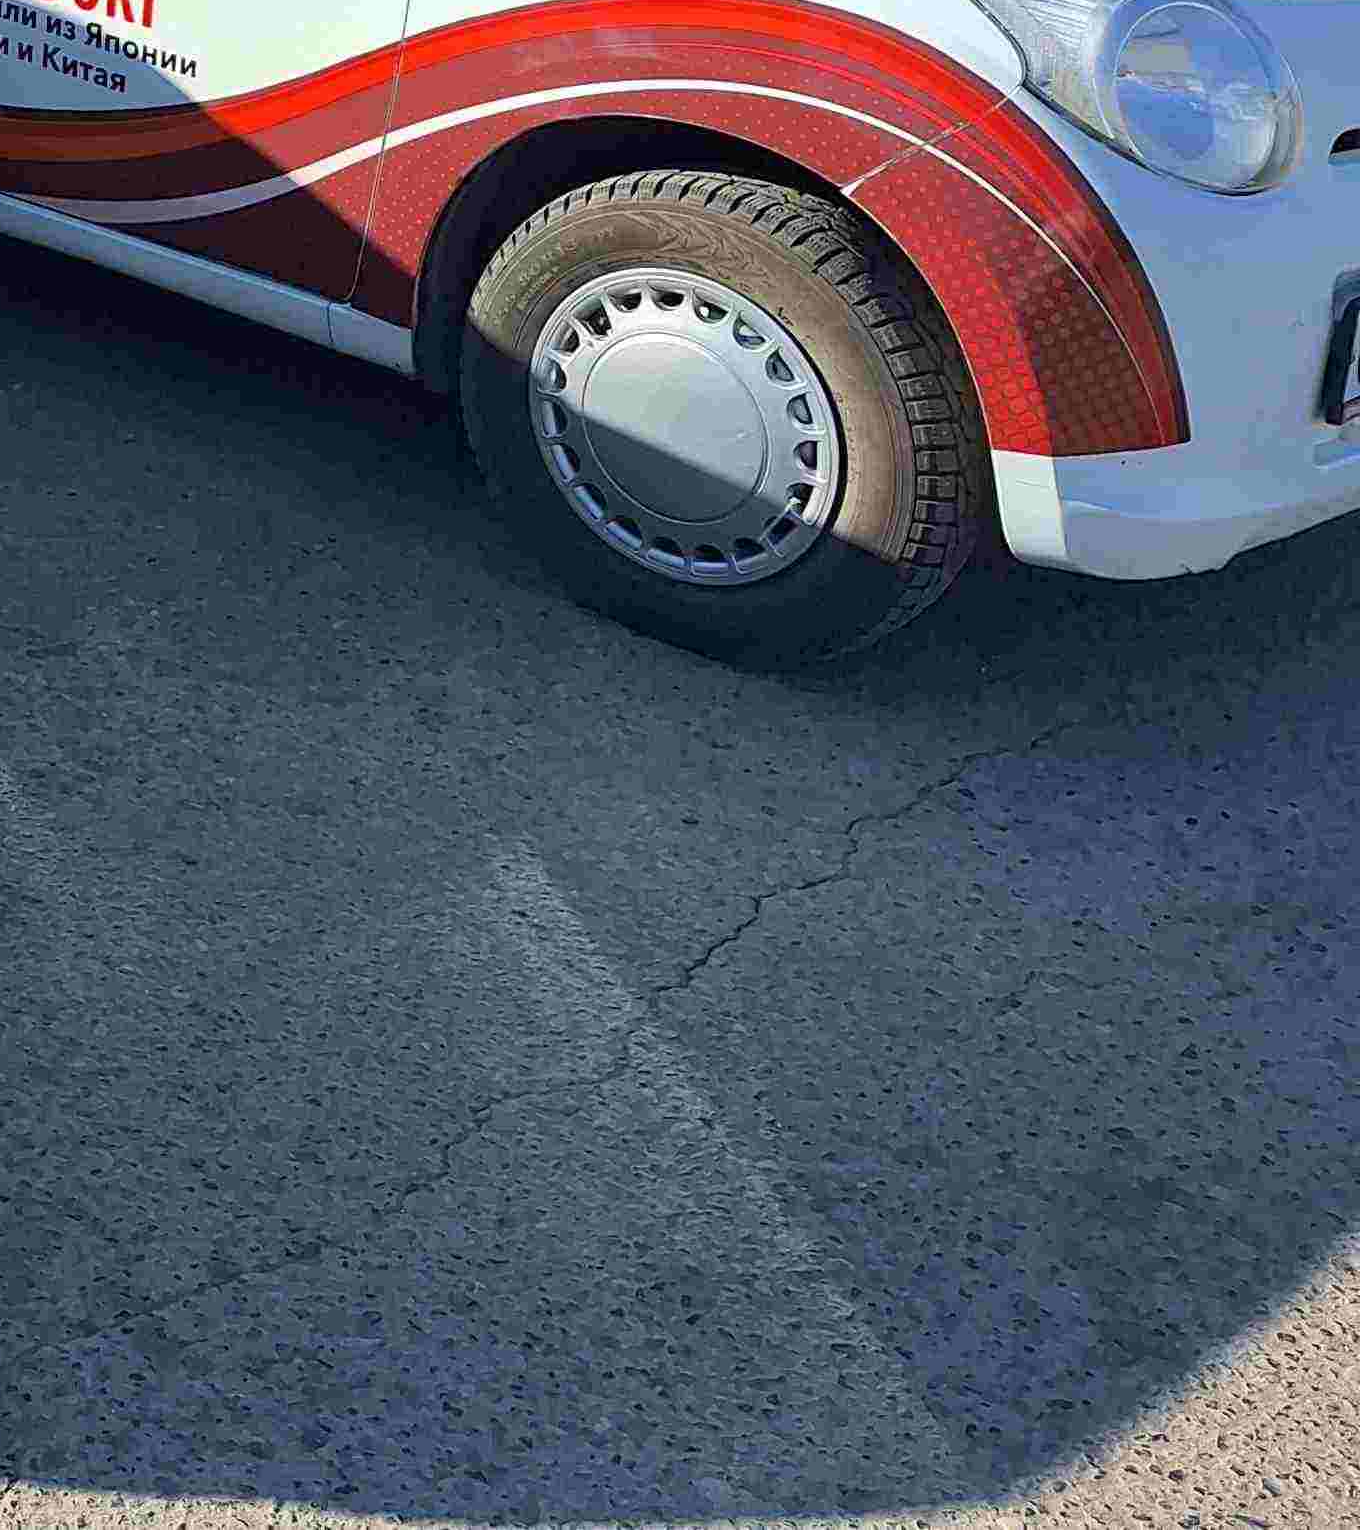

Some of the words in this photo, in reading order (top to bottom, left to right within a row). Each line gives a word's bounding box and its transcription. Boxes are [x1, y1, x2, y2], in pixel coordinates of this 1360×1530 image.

[18, 38, 34, 62] и
[41, 42, 127, 94] Китая
[45, 10, 77, 40] из
[83, 21, 198, 77] Японии
